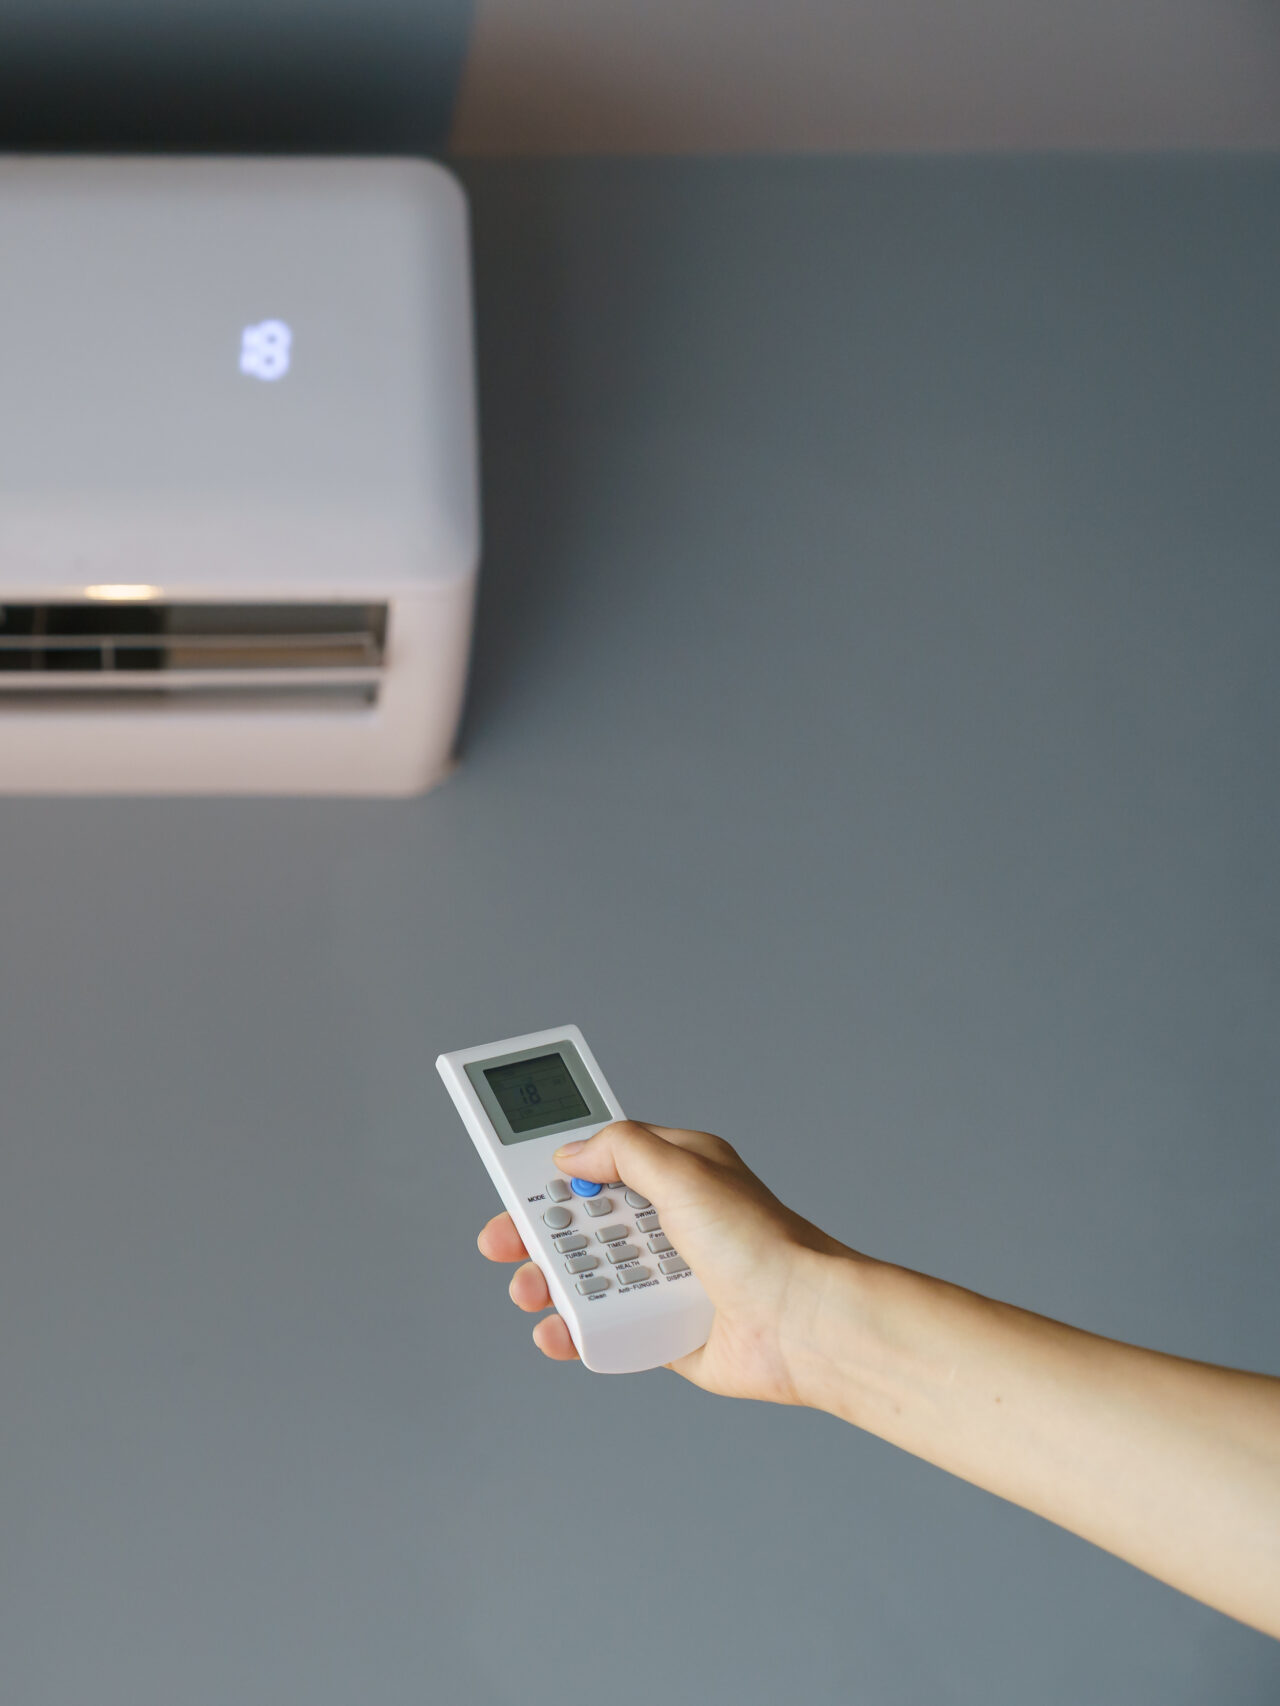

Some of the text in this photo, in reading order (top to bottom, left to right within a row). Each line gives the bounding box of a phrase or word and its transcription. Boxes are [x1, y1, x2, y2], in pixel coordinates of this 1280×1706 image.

[527, 1194, 545, 1202] MODE
[635, 1209, 657, 1219] SWING
[551, 1230, 573, 1239] SWING
[607, 1240, 627, 1249] TIMER
[564, 1250, 587, 1260] TURBO
[616, 1260, 640, 1271] HEALTH
[666, 1271, 691, 1281] DISPLAY
